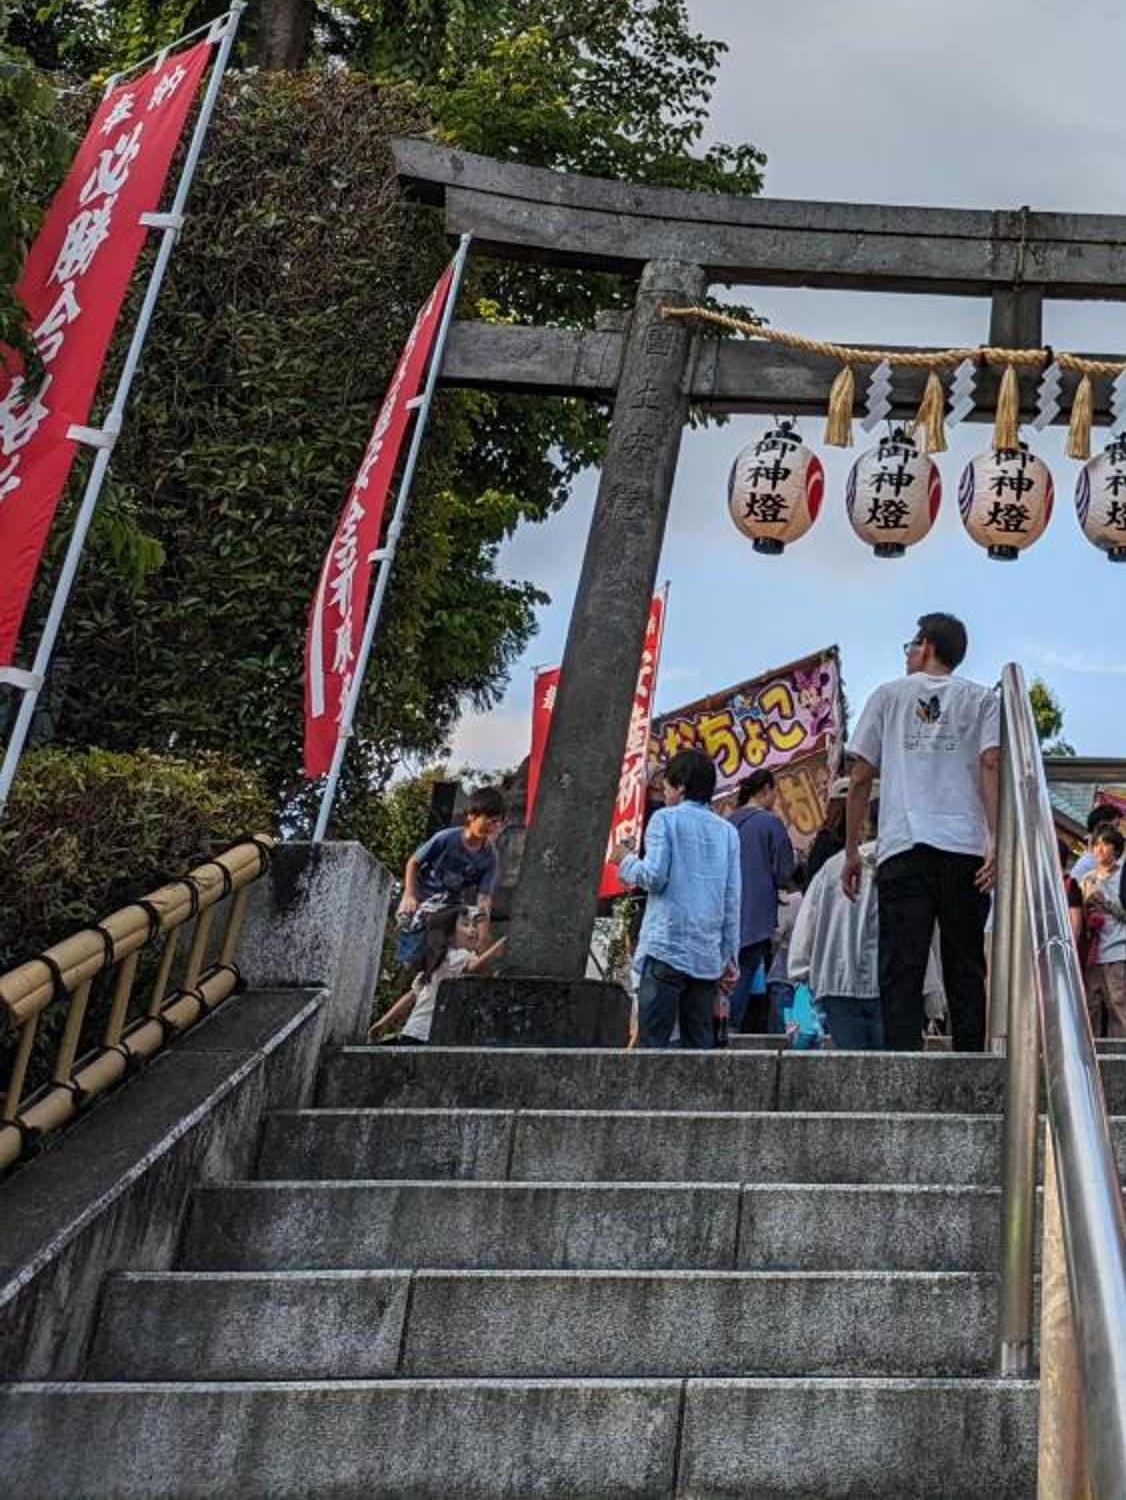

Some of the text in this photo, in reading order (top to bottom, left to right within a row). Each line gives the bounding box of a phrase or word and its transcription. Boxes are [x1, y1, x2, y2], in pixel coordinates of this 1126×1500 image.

[742, 438, 793, 525] 御神燈
[867, 440, 916, 530] 御神燈
